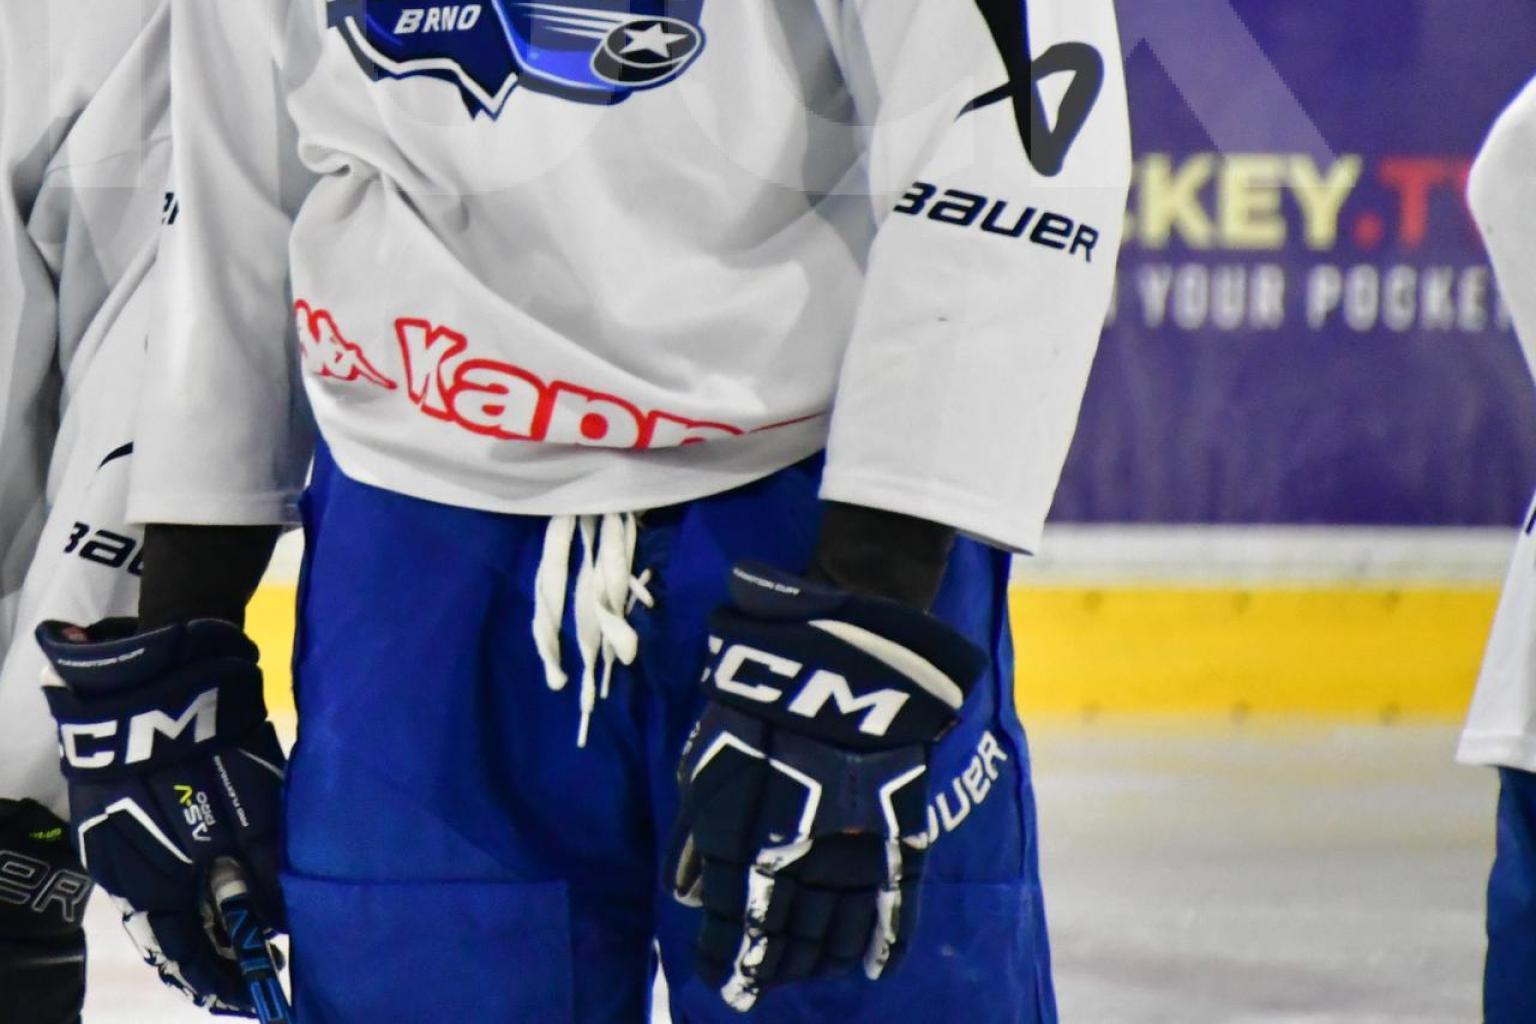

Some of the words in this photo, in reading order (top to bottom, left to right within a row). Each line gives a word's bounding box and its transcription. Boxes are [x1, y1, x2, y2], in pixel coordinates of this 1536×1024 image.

[394, 4, 481, 36] BRNO
[1120, 153, 1480, 252] KEY.T
[1138, 263, 1286, 331] YOUR
[58, 687, 219, 768] CM
